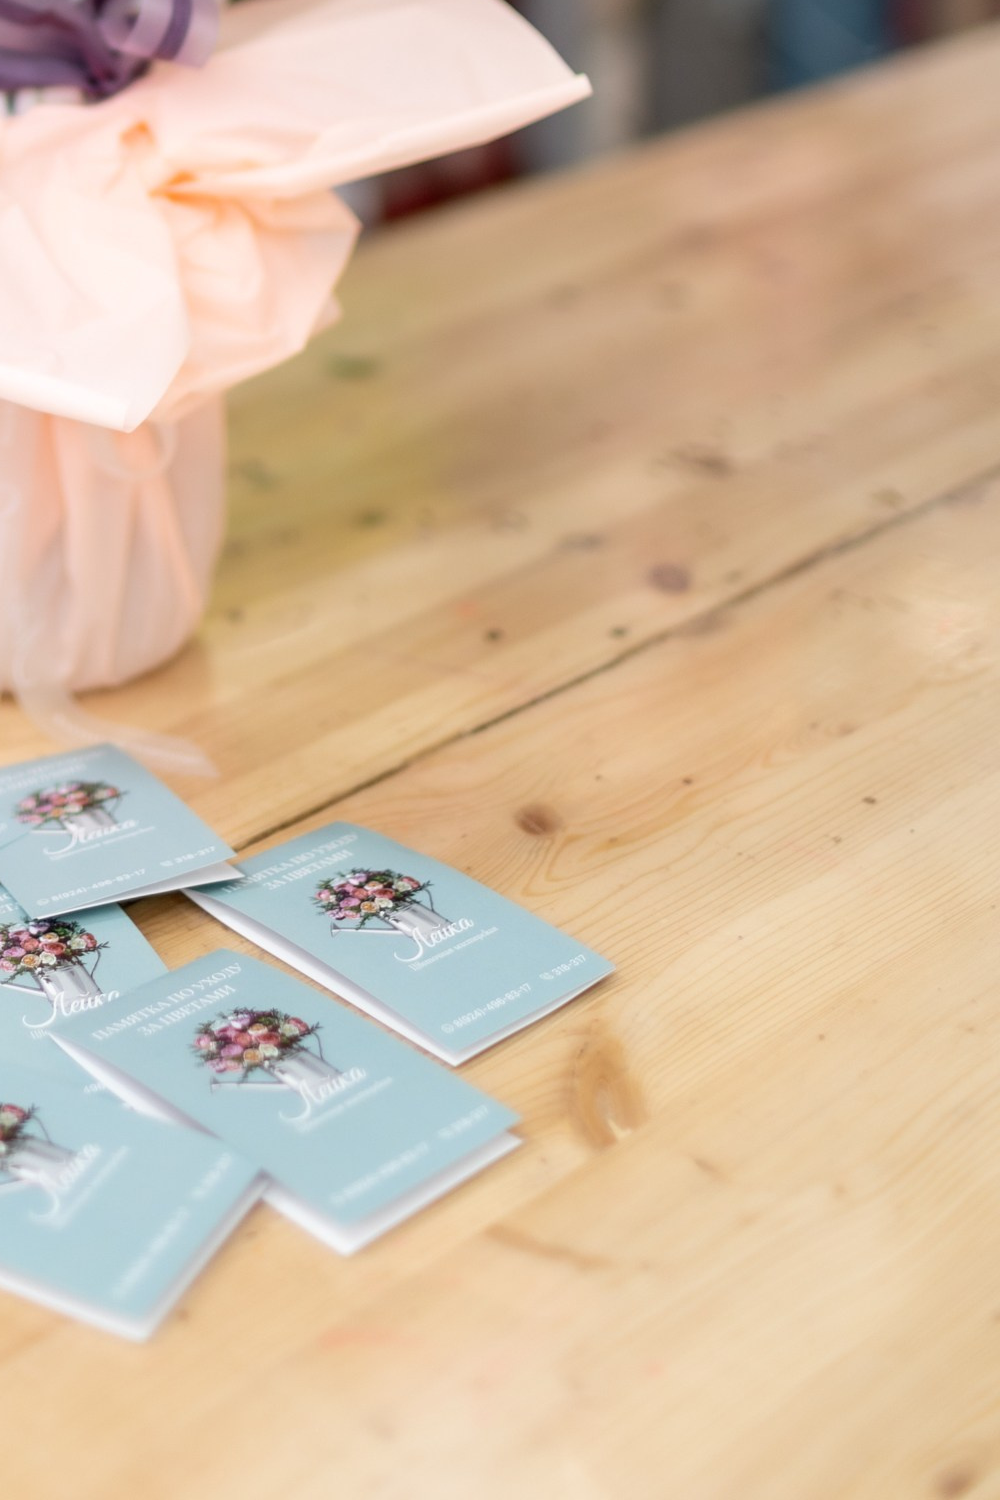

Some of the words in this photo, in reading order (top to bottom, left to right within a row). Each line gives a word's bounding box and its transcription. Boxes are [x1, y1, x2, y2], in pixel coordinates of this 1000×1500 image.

[394, 916, 475, 963] Лейка
[551, 953, 588, 978] 318-317
[92, 1000, 171, 1041] ПАМЯТКА
[167, 987, 195, 1004] ПО
[192, 962, 242, 991] УХОДУ
[137, 1022, 164, 1037] ЗА
[159, 984, 237, 1026] ЦВЕТАМИ
[278, 1066, 368, 1123] Лейка
